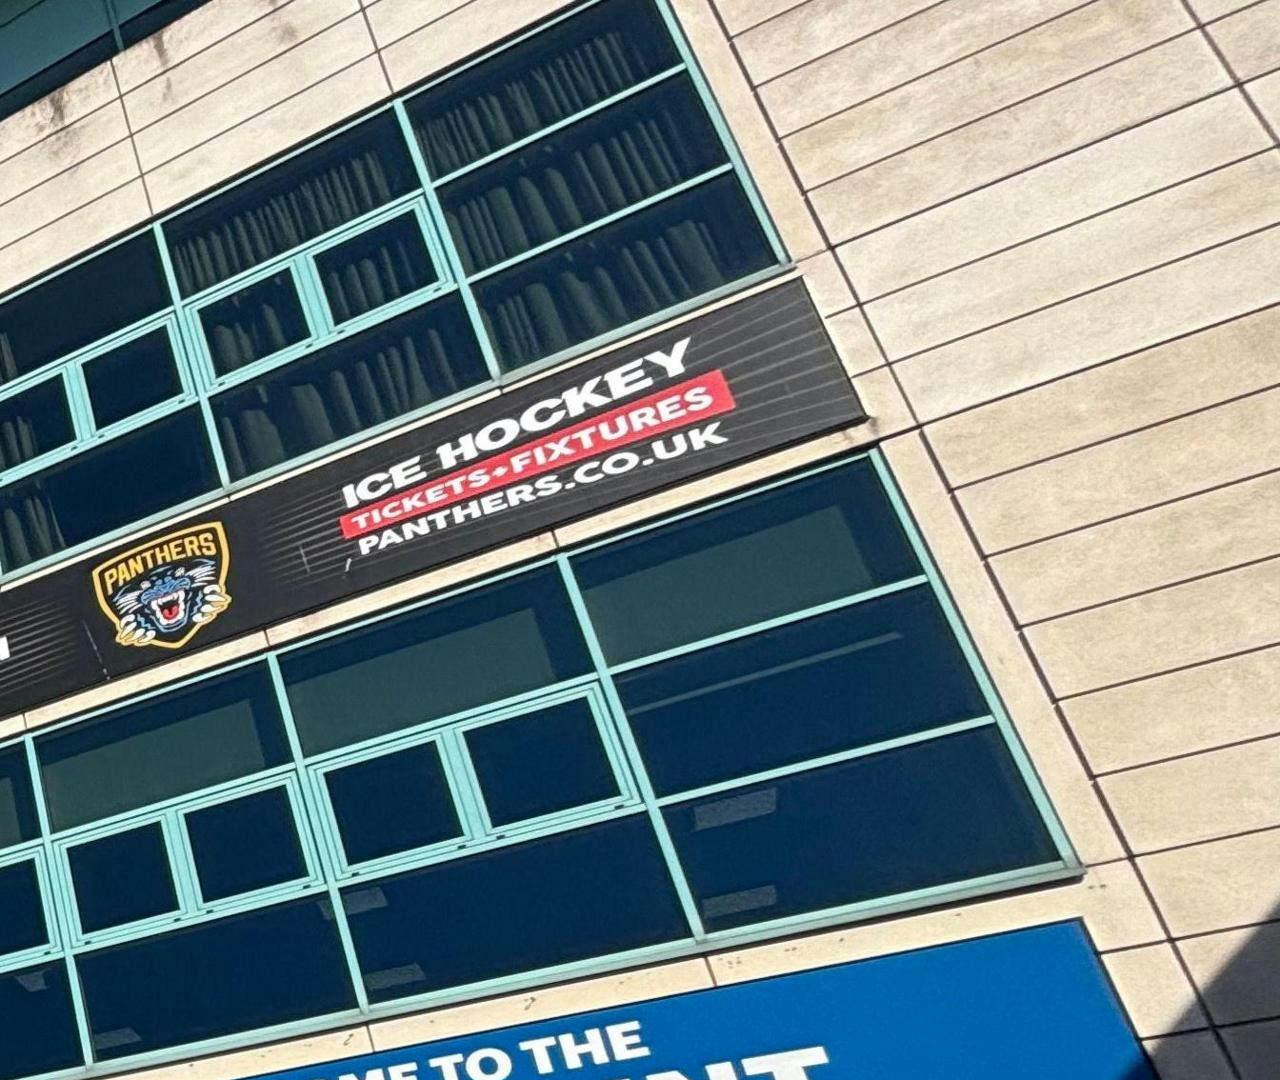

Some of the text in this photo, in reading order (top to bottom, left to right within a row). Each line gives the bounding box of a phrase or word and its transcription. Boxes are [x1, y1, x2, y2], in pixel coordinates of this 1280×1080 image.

[341, 337, 692, 508] ICE HOCKEY
[358, 422, 729, 556] PANTHERS.CO.UK
[104, 532, 217, 596] PANTHERS
[519, 1020, 651, 1072] THE
